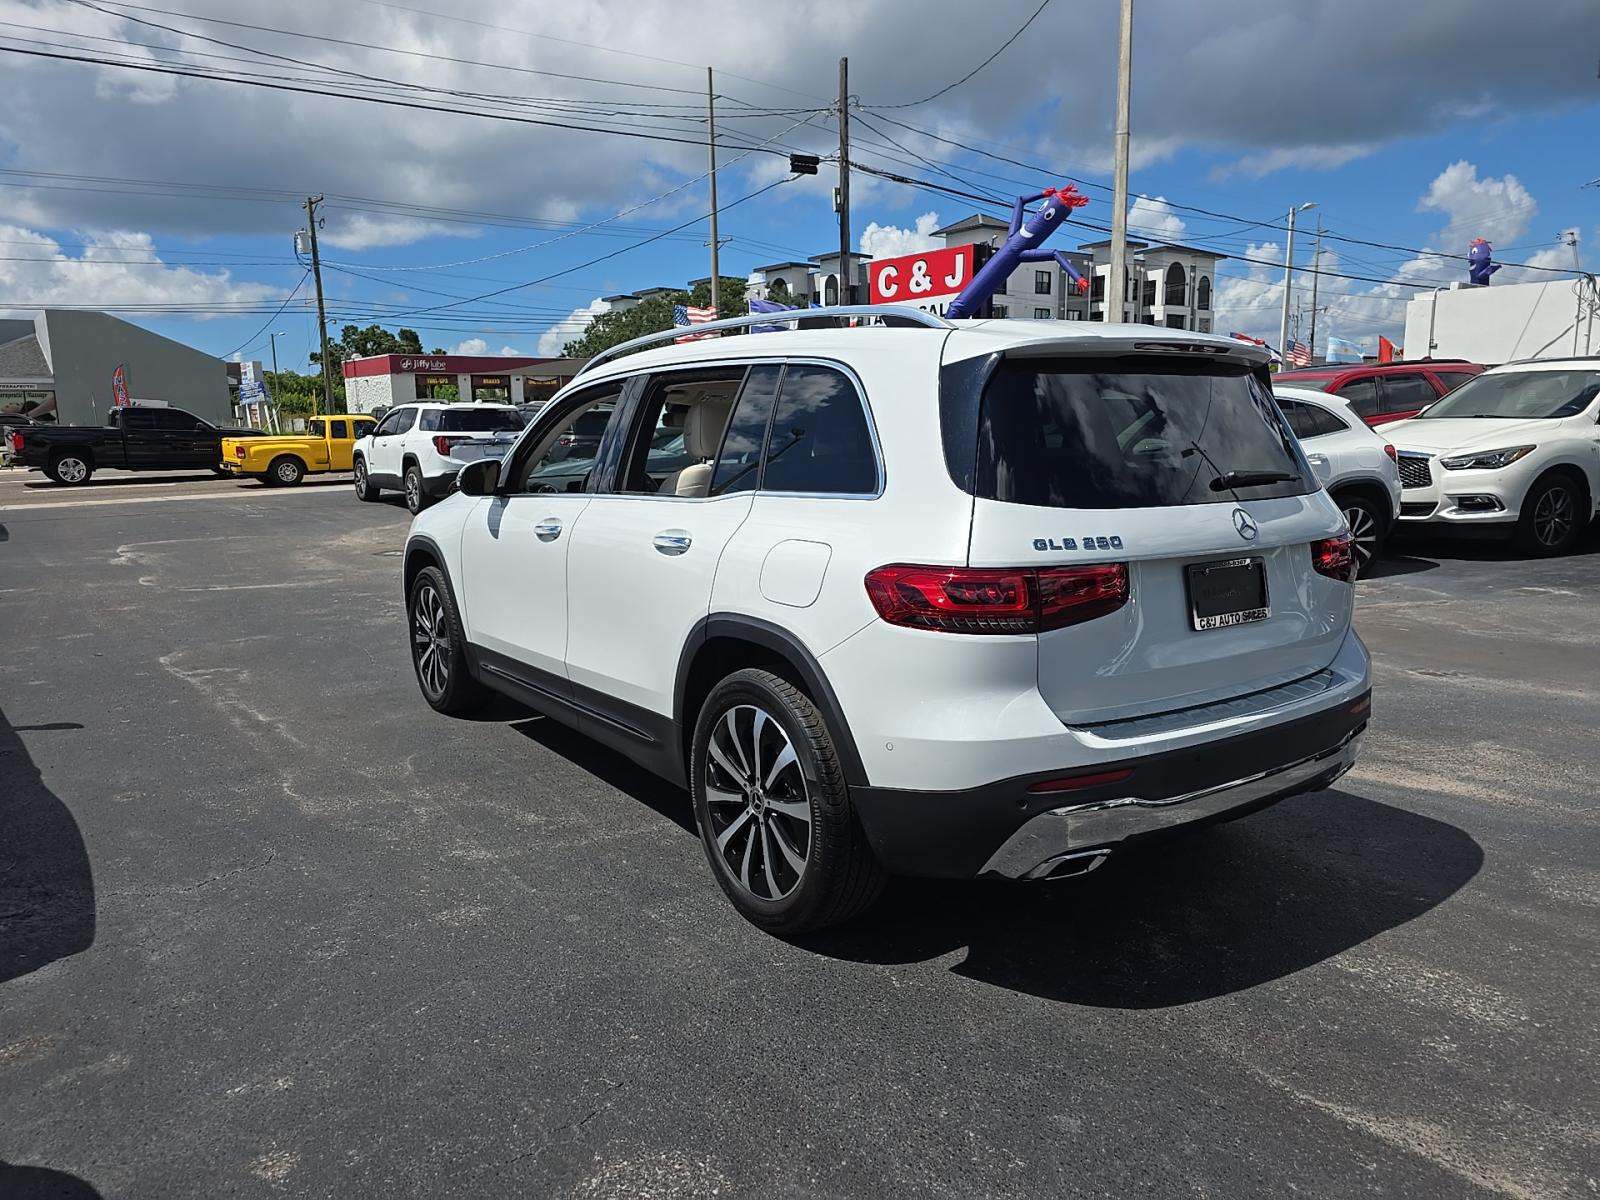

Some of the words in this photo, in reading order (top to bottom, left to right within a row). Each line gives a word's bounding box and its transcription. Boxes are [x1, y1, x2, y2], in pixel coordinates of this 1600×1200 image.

[878, 265, 898, 297] C
[909, 259, 932, 293] &
[944, 252, 964, 288] J
[1032, 538, 1078, 551] GLB
[1082, 535, 1124, 551] 250
[1219, 612, 1241, 627] AUTO
